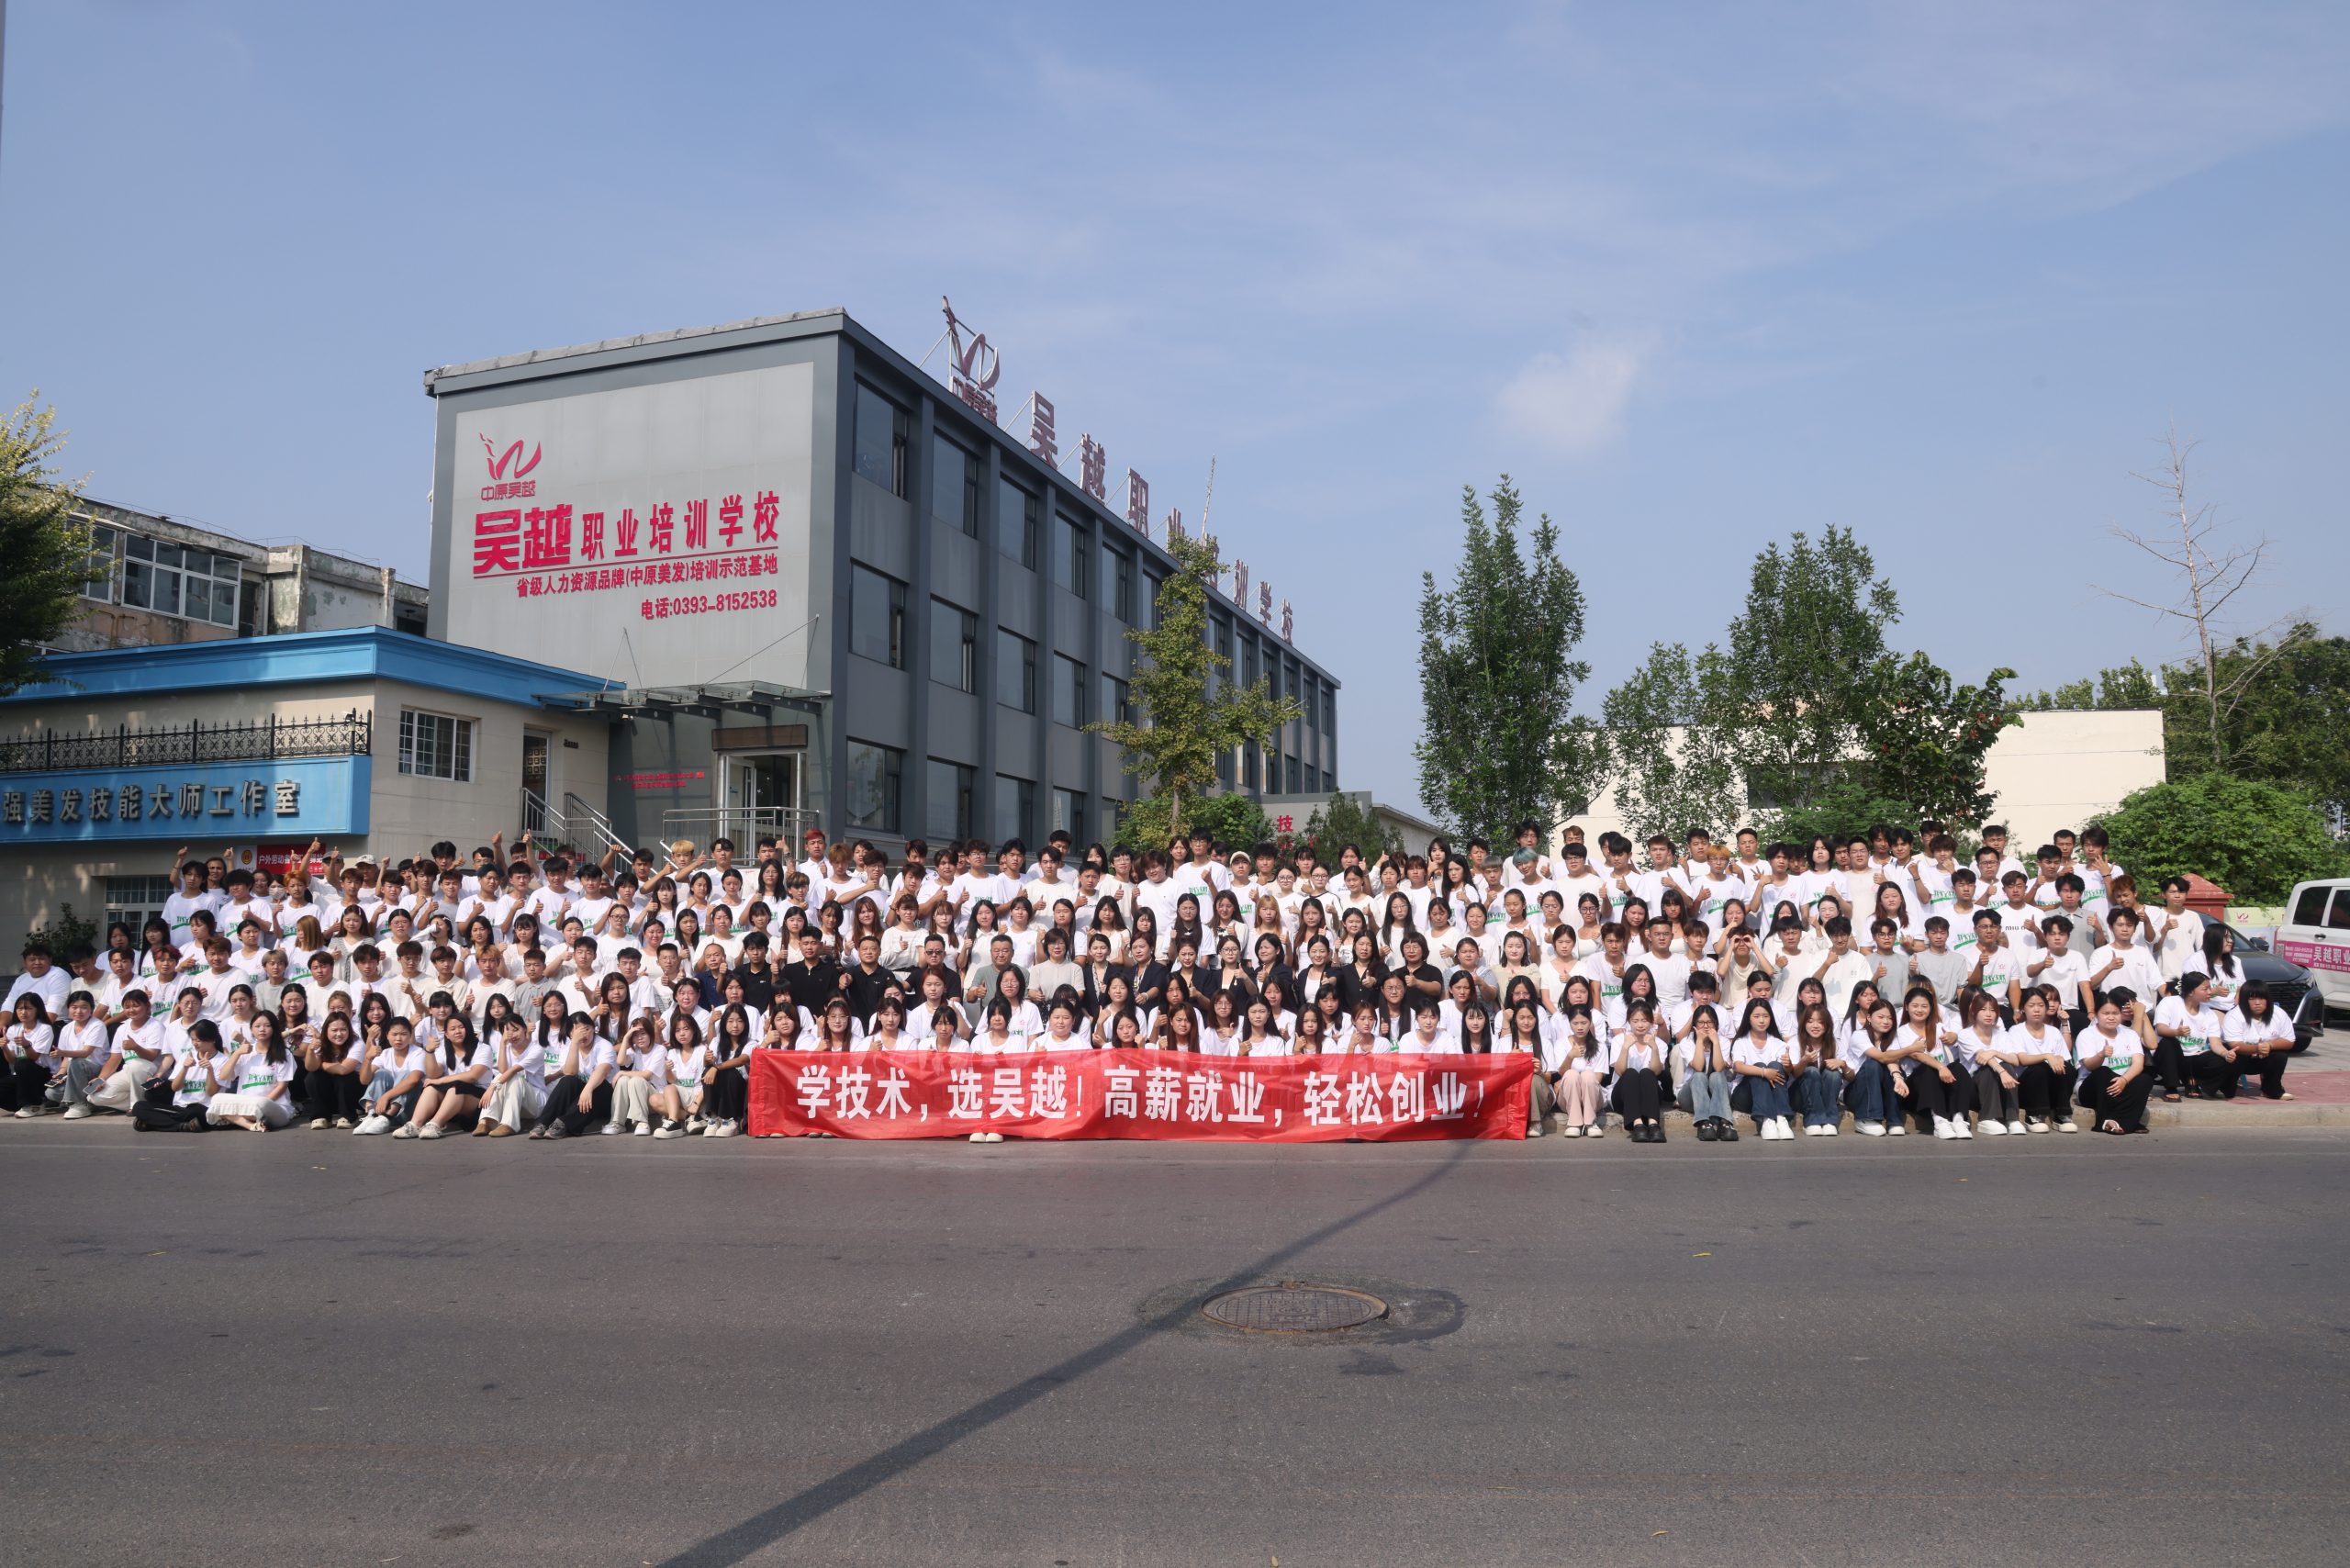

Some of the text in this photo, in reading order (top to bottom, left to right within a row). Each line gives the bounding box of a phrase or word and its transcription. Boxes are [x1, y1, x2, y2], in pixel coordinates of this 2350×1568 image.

[481, 479, 536, 501] 中原吴越
[473, 489, 780, 575] 吴越职业培训学校
